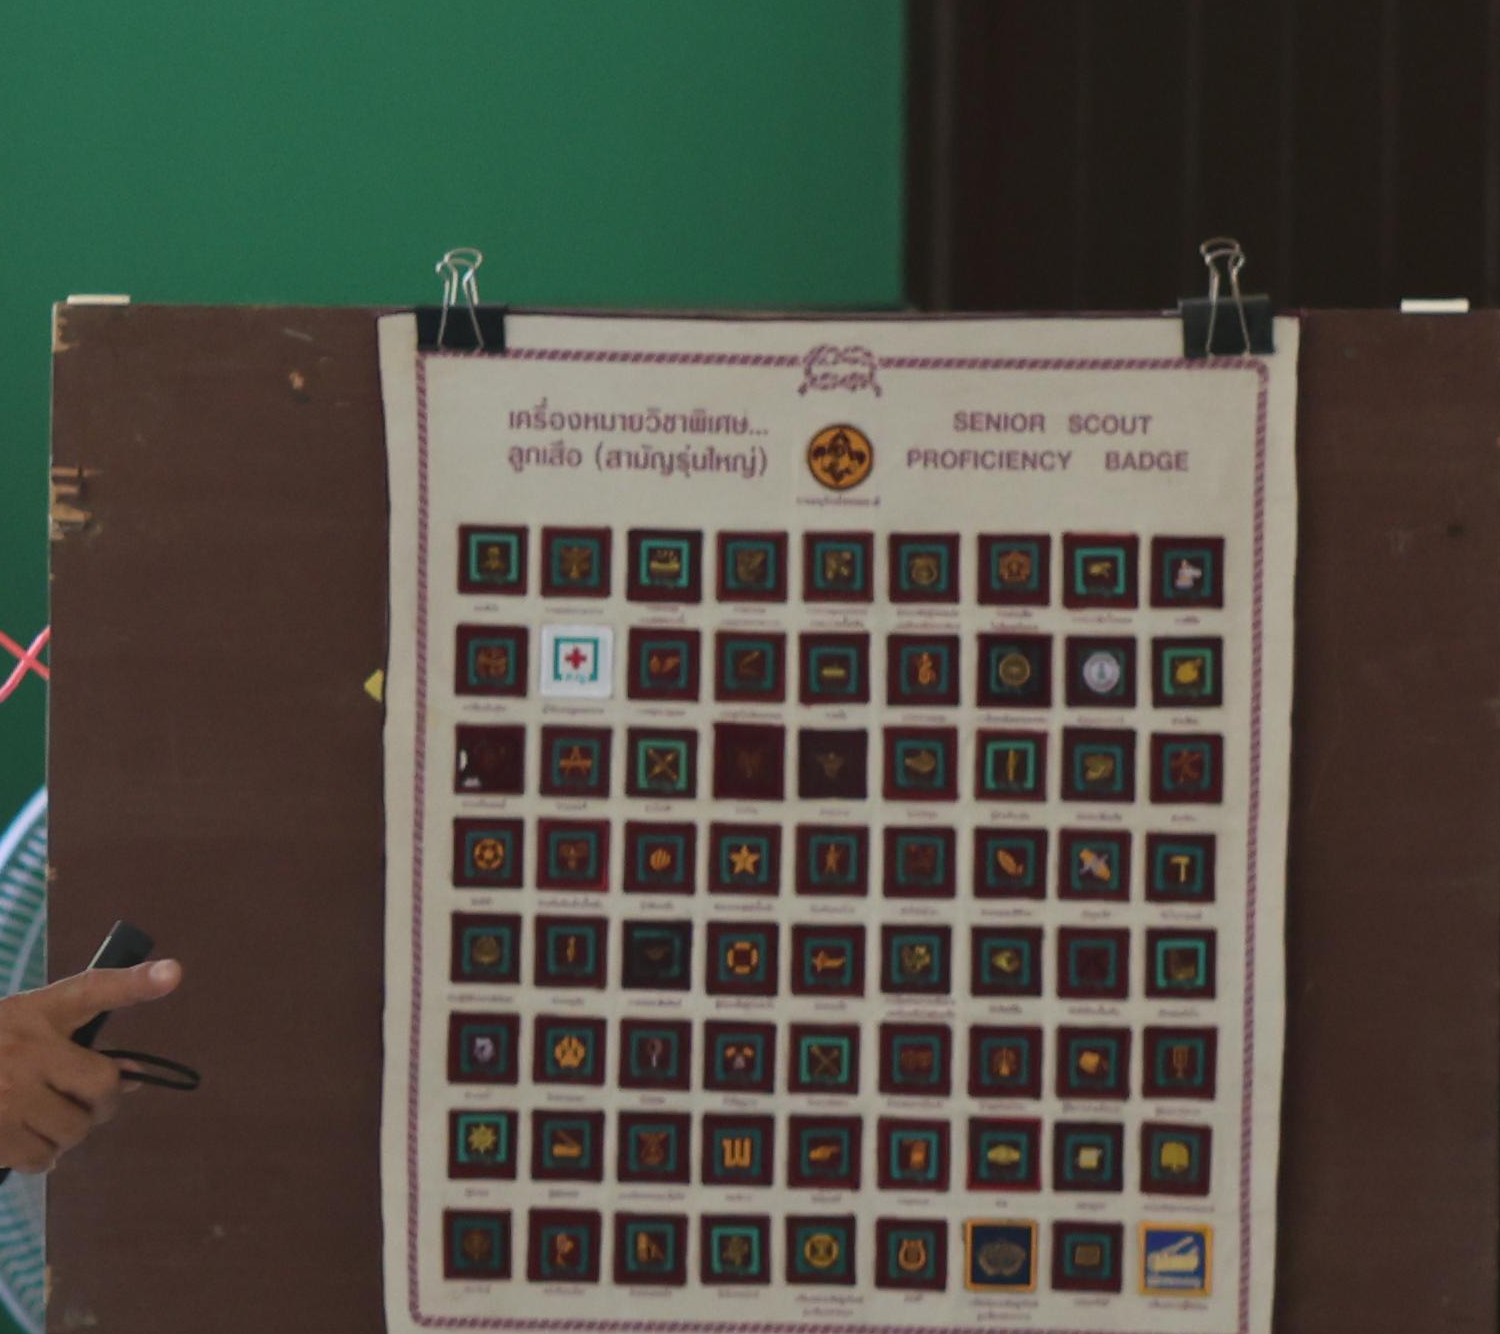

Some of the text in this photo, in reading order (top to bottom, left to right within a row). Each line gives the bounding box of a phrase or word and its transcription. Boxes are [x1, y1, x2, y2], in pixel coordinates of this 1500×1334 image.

[953, 411, 1153, 435] SENIOR SCOUT
[508, 440, 768, 478] ลูกเสือ (สามัญรุ่นใหญ่)
[906, 448, 1190, 472] PROFICIENCY BADGE
